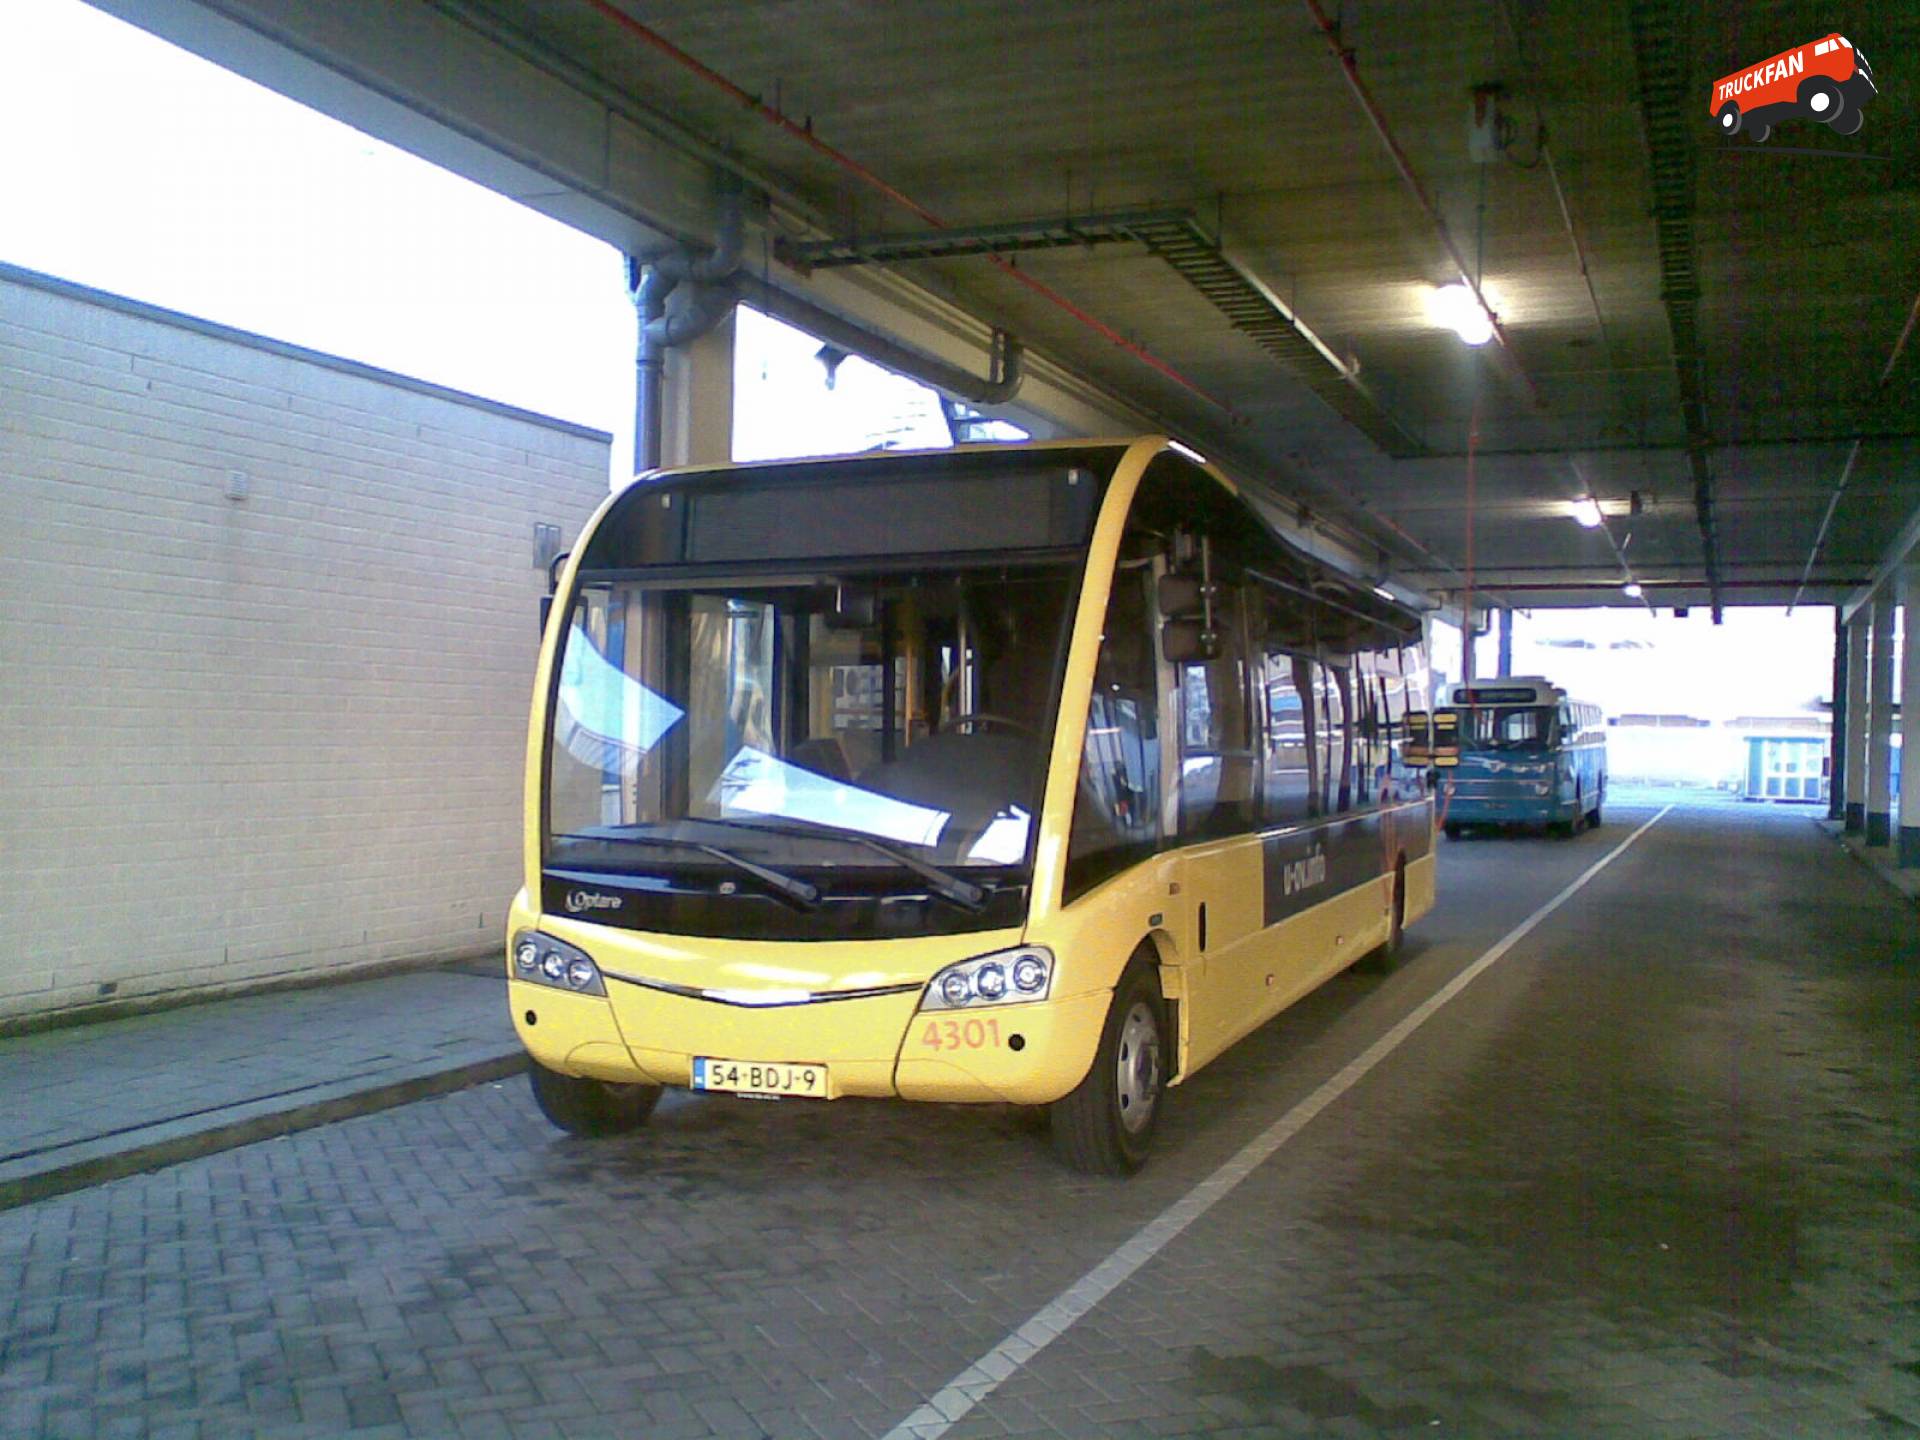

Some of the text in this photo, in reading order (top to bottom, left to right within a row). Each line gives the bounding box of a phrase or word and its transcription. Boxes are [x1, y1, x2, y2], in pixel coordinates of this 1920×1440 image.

[575, 891, 623, 911] Optare
[922, 1018, 1000, 1051] 4301
[712, 1065, 816, 1091] 54-BDJ-9
